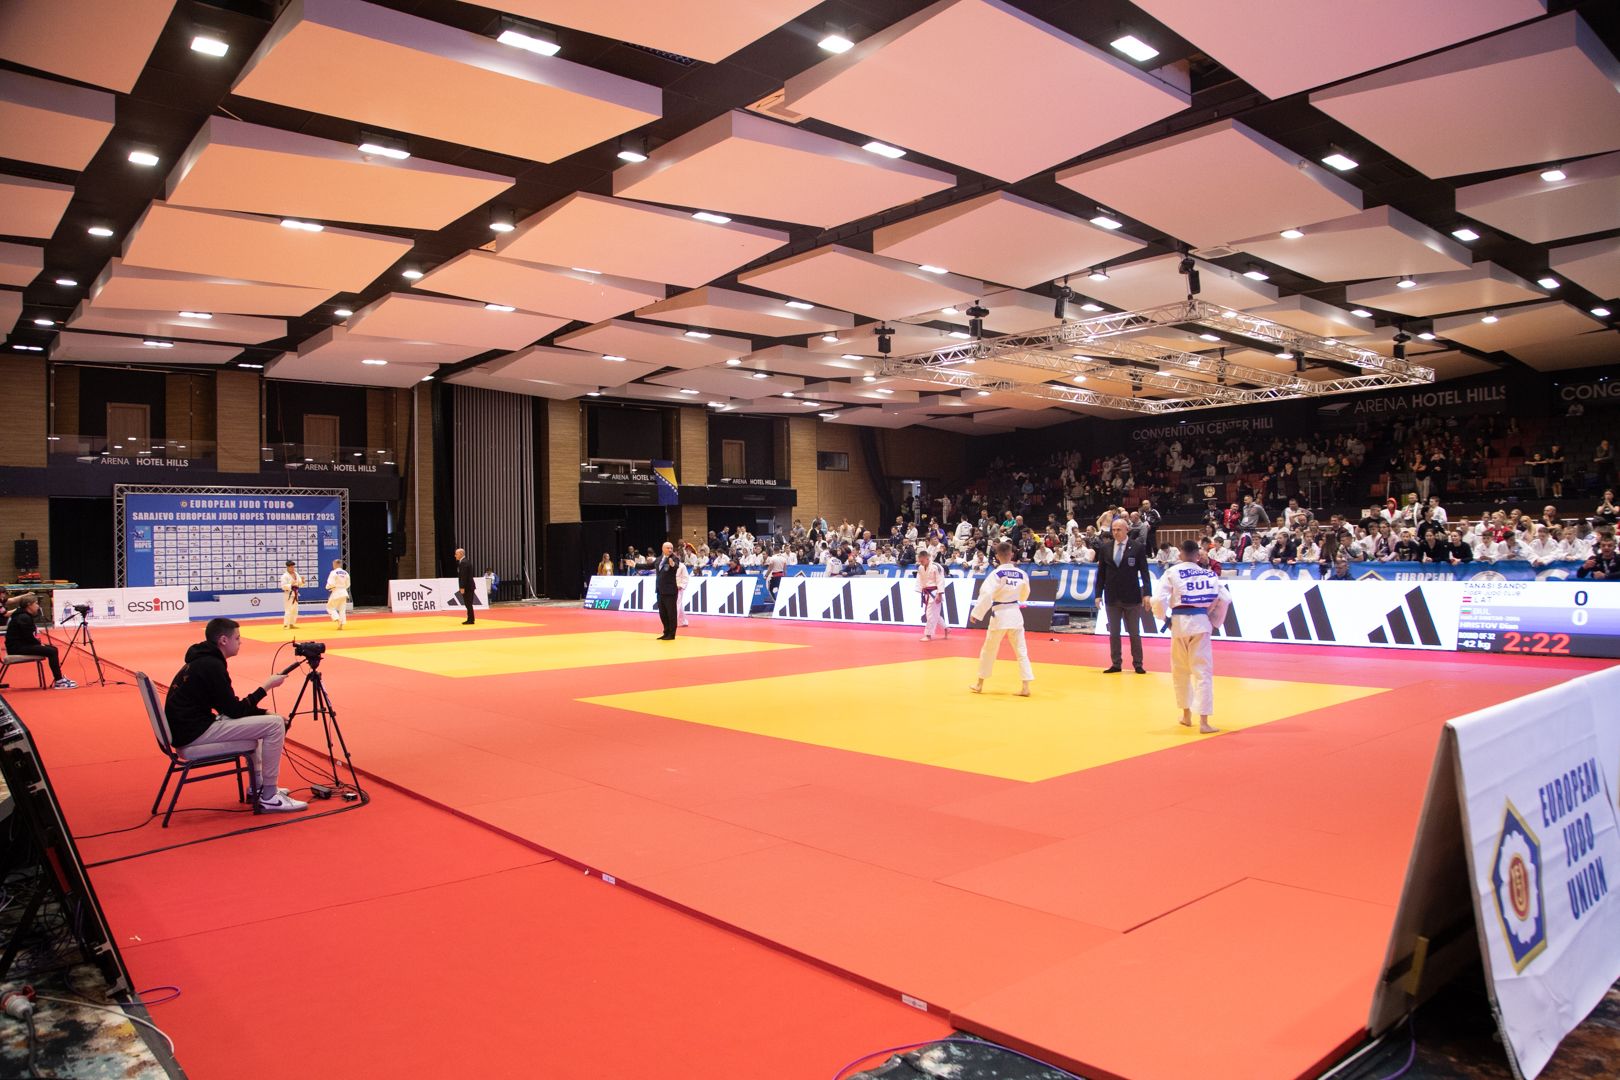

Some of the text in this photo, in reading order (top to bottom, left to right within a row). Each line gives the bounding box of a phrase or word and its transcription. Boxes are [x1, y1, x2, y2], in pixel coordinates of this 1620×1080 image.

[1353, 396, 1408, 414] ARENA
[1411, 387, 1462, 408] HOTEL
[1132, 422, 1205, 441] CONVENTION
[1206, 419, 1249, 435] CENTER
[100, 457, 189, 467] ARENA HOTEL HILLS
[304, 463, 377, 473] ARENA HOTEL HILLS
[611, 473, 630, 481] ARENA
[189, 500, 286, 509] EUROPEAN JUDO TOUR
[132, 512, 335, 521] SARAJEVO EUROPEAN JUDO HOPES TOURNAMENT 2025
[1186, 580, 1214, 591] BUL
[397, 591, 424, 601] IPPON
[1574, 590, 1589, 606] 0
[127, 597, 185, 613] essimo
[412, 600, 436, 611] GEAR
[594, 600, 610, 609] 1:47
[1572, 608, 1589, 626] 0
[1503, 631, 1571, 654] 2:22
[1538, 757, 1601, 829] EUROPEAN
[1563, 812, 1595, 867] JUDO
[1567, 855, 1608, 920] UNION
